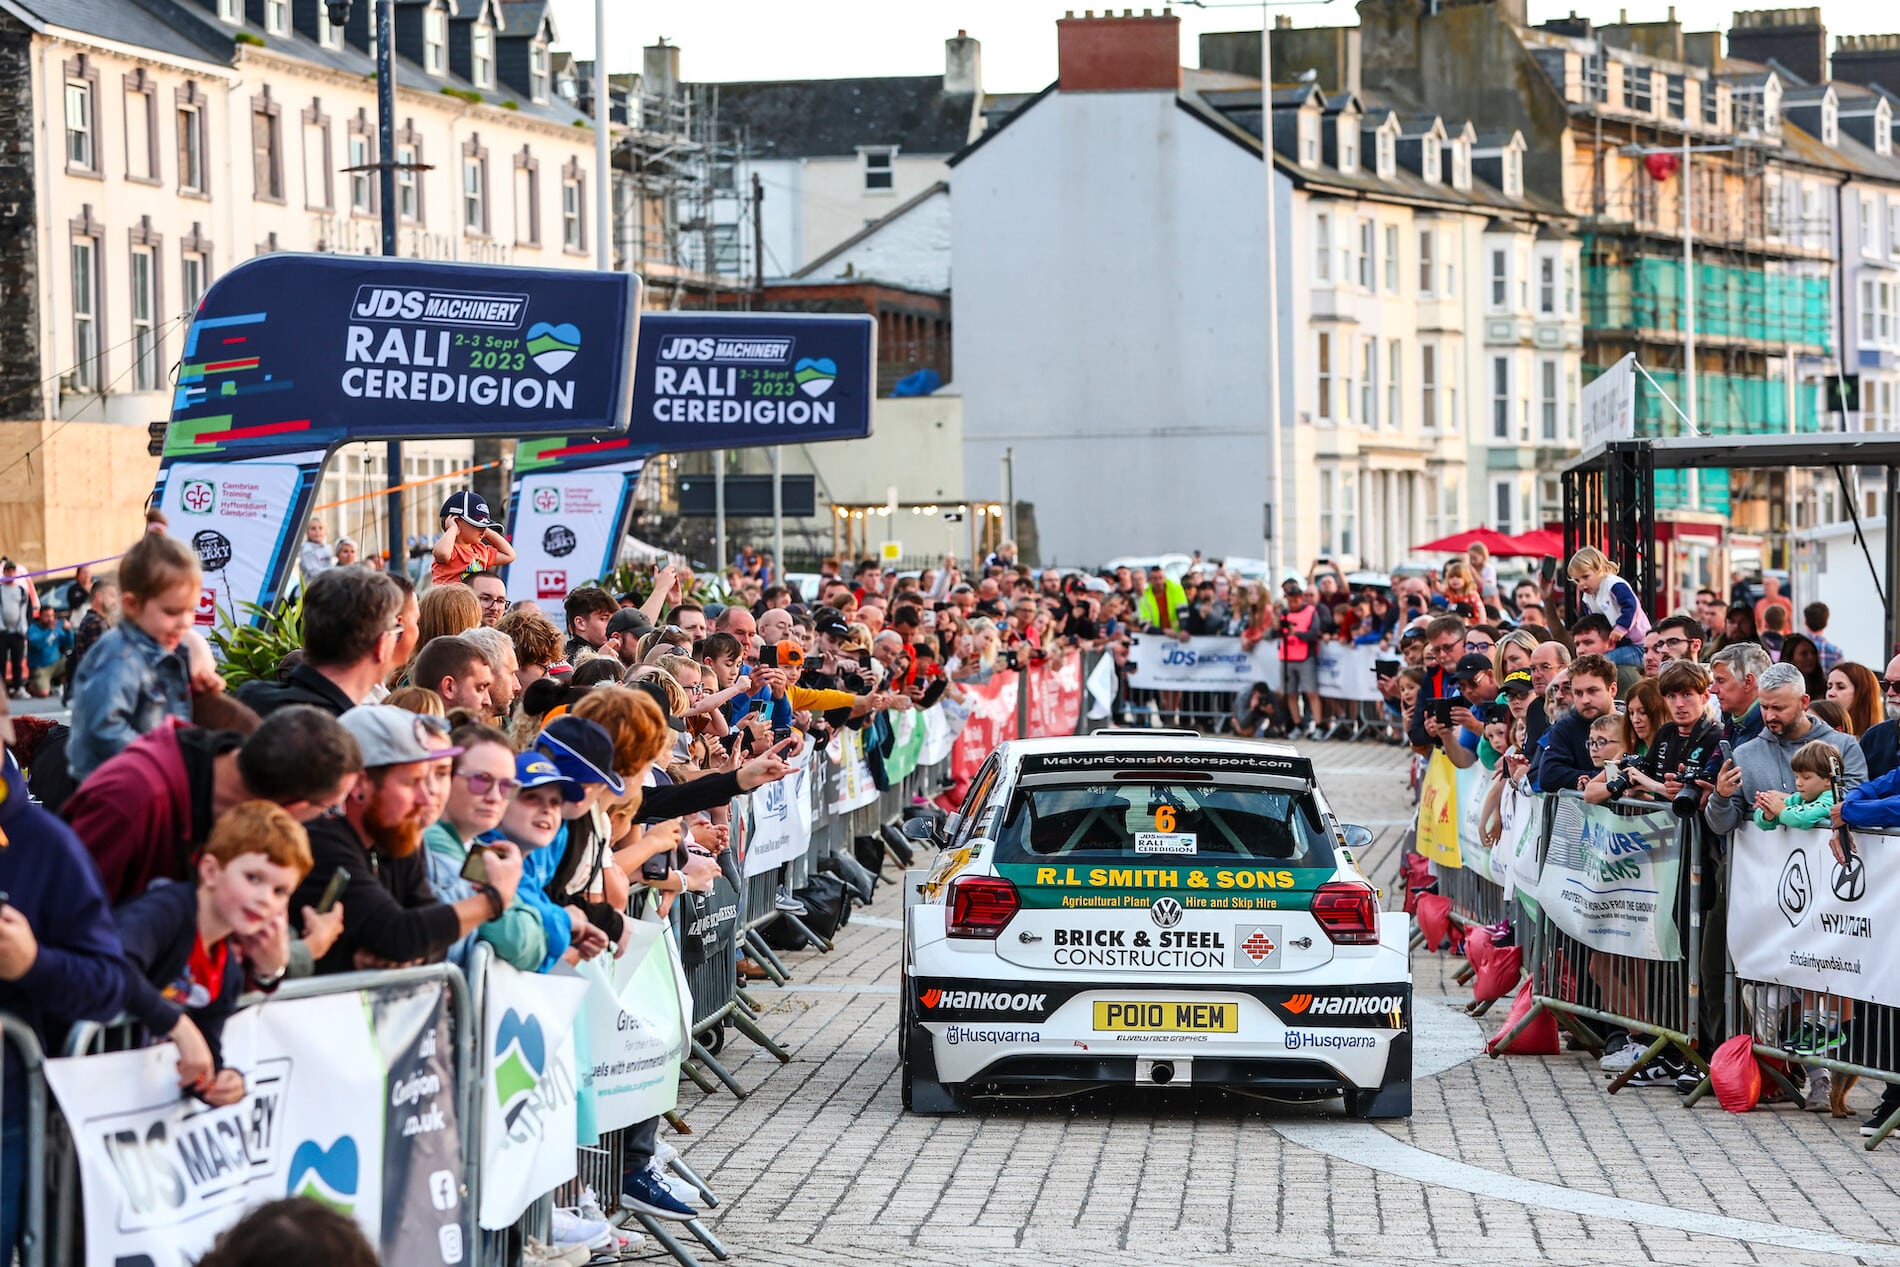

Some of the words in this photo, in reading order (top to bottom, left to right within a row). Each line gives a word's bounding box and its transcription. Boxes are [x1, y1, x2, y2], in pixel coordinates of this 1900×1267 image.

[357, 289, 425, 319] JDS
[424, 298, 521, 322] MACHINERY
[345, 326, 450, 368] RALI
[454, 333, 481, 347] 2-3
[485, 336, 520, 352] Sept
[661, 338, 716, 361] JDS
[714, 343, 789, 358] MACHINERY
[470, 352, 526, 371] 2023
[654, 366, 736, 396] RALI
[739, 369, 760, 379] 2-3
[763, 369, 790, 381] Sept
[341, 367, 576, 410] CEREDIGION
[752, 382, 796, 396] 2023
[653, 398, 836, 424] CEREDIGION
[222, 482, 259, 491] Cambrian
[222, 490, 252, 499] Training
[220, 509, 257, 518] Cambrian
[1162, 649, 1196, 666] JDS
[1043, 755, 1293, 769] MelvynEvansMotorsport.com
[1155, 805, 1176, 833] 6
[1036, 867, 1082, 885] R.L
[1088, 869, 1178, 888] SMITH
[1186, 870, 1210, 888] &
[1216, 871, 1295, 888] SONS
[1062, 895, 1122, 908] Agricultural
[1124, 895, 1150, 907] Plant
[1186, 896, 1207, 908] Hire
[1210, 896, 1229, 908] and
[1231, 897, 1253, 910] Skip
[1256, 897, 1277, 909] Hire
[1820, 913, 1872, 938] HYUNDAI
[1054, 929, 1124, 947] BRICK
[1133, 931, 1152, 947] &
[1160, 931, 1225, 949] STEEL
[1054, 948, 1224, 968] CONSTRUCTION
[1789, 951, 1862, 975] sinclairhyundai.co.uk
[1176, 1005, 1224, 1028] MEM
[960, 1028, 1040, 1045] Husqvarna
[1302, 1033, 1376, 1050] Husqvarna
